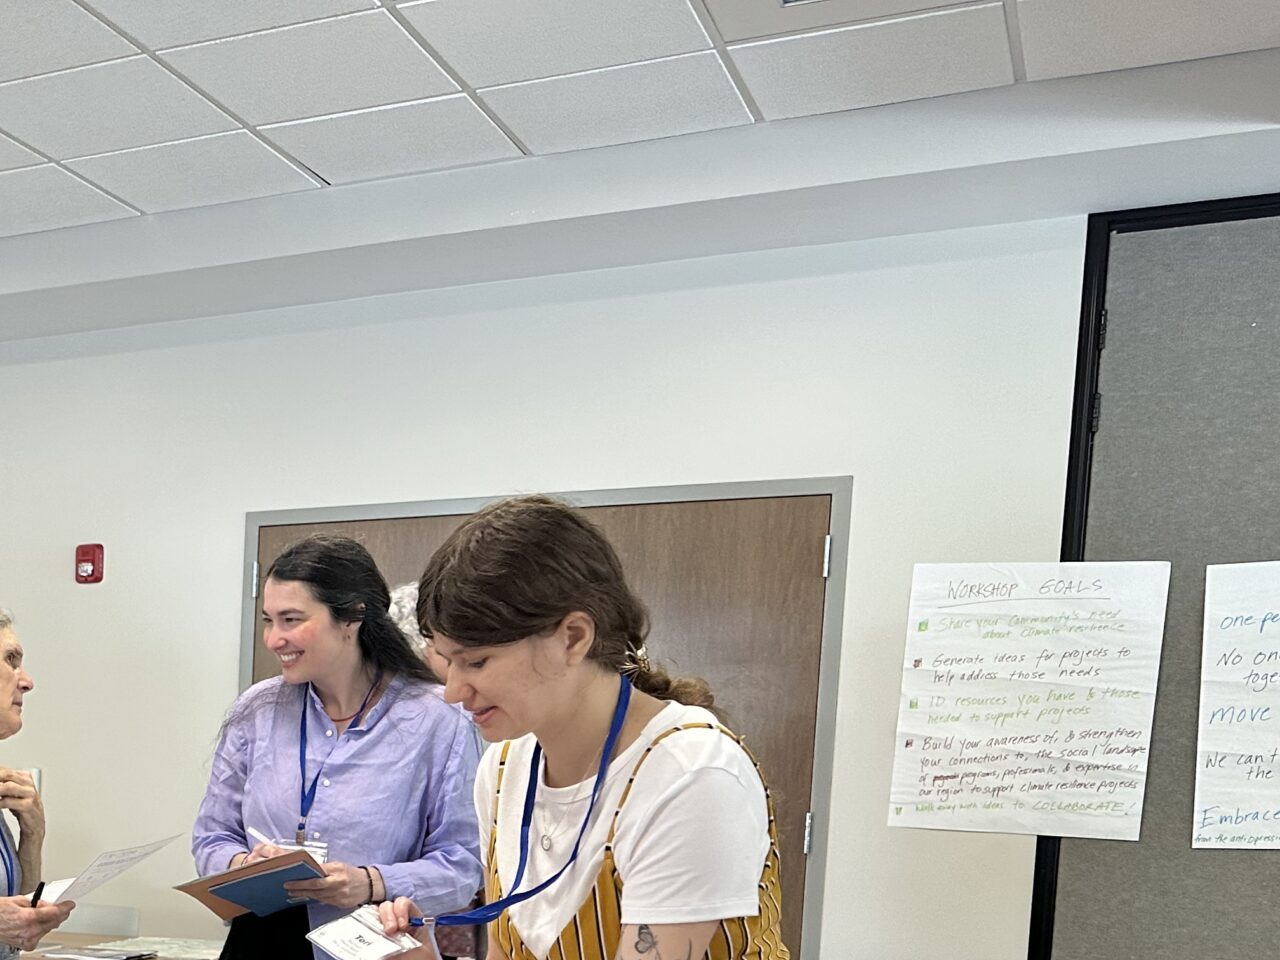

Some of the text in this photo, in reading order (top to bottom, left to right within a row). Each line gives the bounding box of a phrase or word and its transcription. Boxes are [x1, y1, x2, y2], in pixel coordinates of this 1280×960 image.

[948, 580, 1103, 599] WORKSHOP GOALS
[933, 647, 1131, 667] Generate ideas for projects to
[1217, 648, 1243, 667] No
[933, 666, 1100, 685] help address those needs
[955, 695, 1007, 705] resources
[1047, 690, 1076, 702] have
[1102, 688, 1140, 699] those
[971, 713, 980, 723] to
[985, 710, 1030, 728] support
[1037, 705, 1091, 723] projects
[922, 736, 953, 751] Build
[959, 738, 980, 756] your
[986, 733, 1038, 748] awareness
[1078, 728, 1142, 746] strengthen
[920, 753, 942, 769] your
[949, 752, 1009, 767] connections
[1036, 748, 1053, 760] the
[1206, 753, 1226, 769] We
[1246, 766, 1274, 780] the
[937, 786, 964, 801] region
[1097, 779, 1138, 793] projects
[355, 935, 372, 946] Tori
